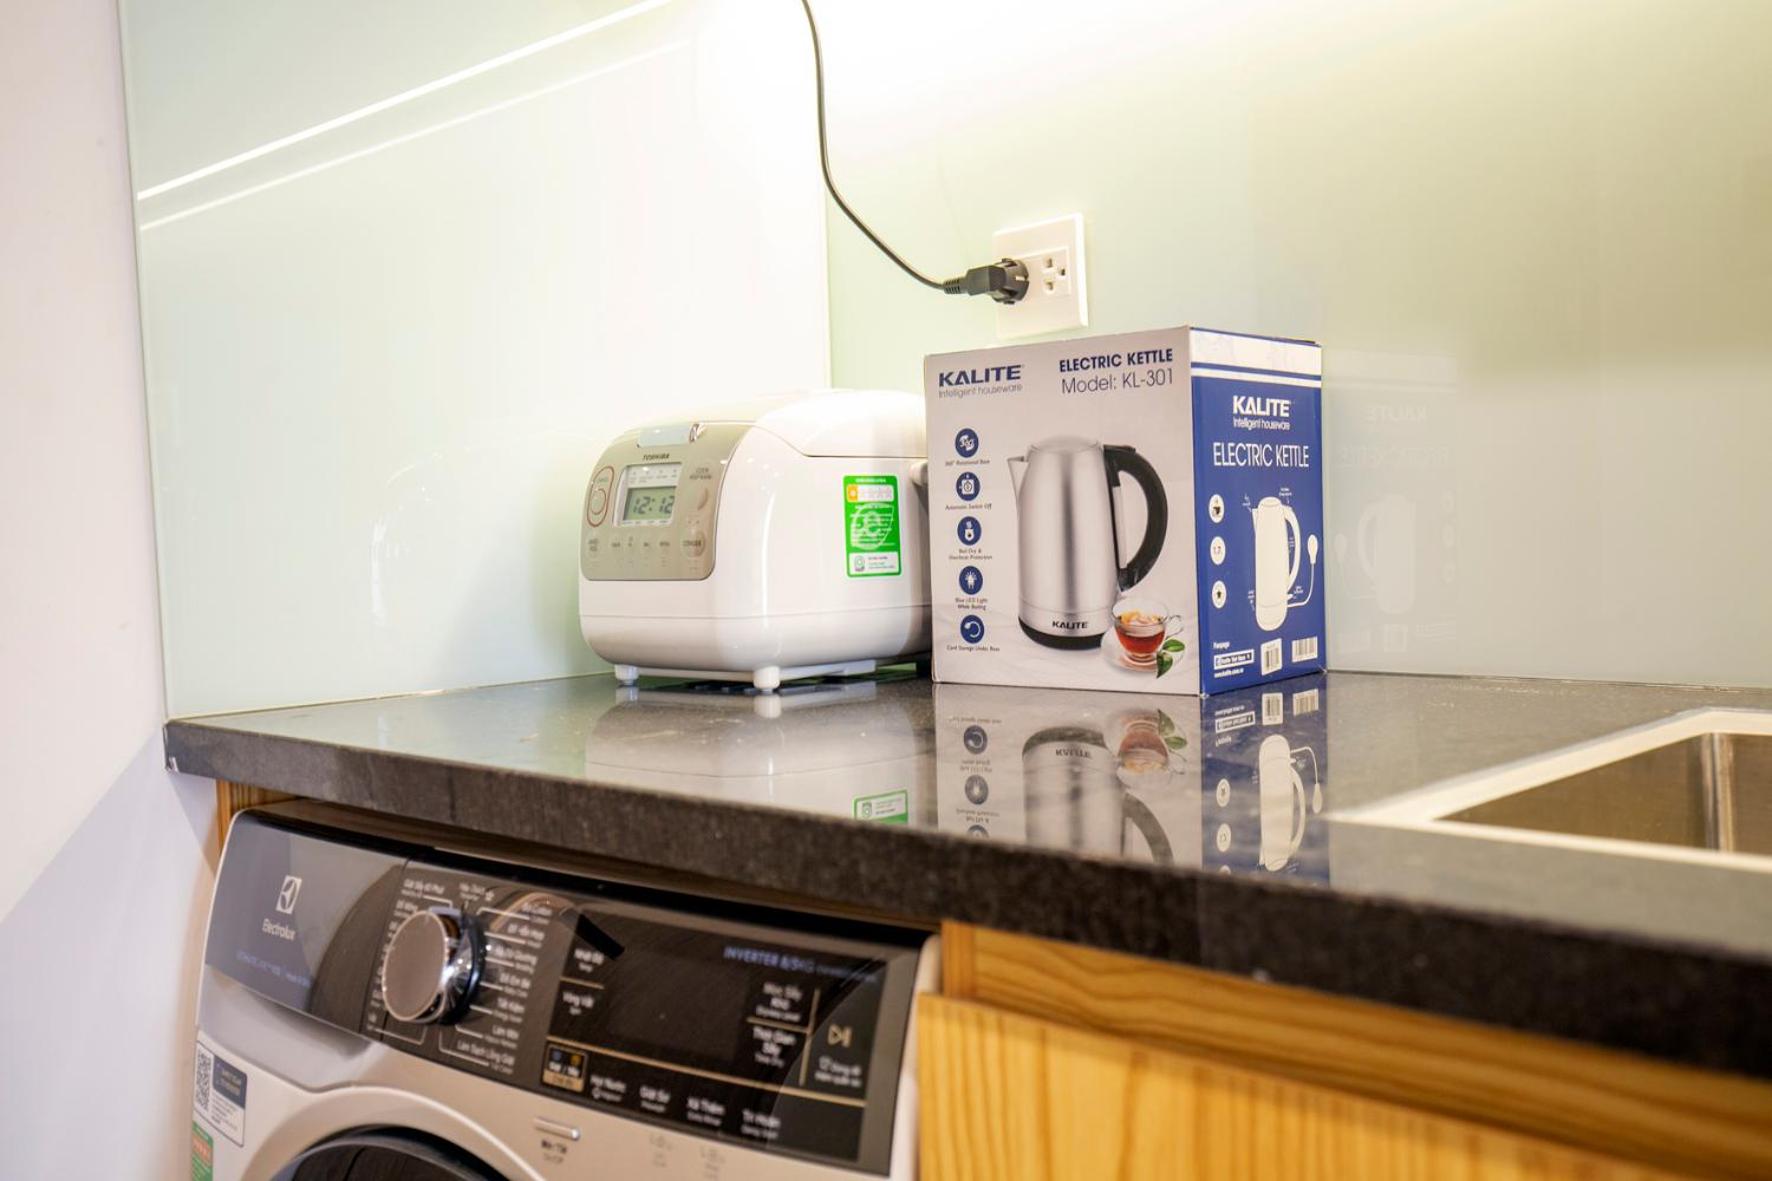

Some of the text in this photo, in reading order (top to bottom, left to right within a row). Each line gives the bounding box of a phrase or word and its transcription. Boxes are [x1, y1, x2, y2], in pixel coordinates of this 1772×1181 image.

[1059, 348, 1172, 372] ELECTRIC KETTLE
[939, 364, 1022, 387] KALITE
[1061, 368, 1173, 394] Model: KL-301
[939, 384, 1023, 399] Intelligent houseware
[1232, 395, 1290, 417] KALITE
[1233, 417, 1291, 430] Intelligent houseware
[1213, 442, 1273, 467] ELECTRIC
[1275, 444, 1310, 467] KETTLE
[1052, 620, 1088, 629] KALITE
[262, 918, 296, 941] Electrolux
